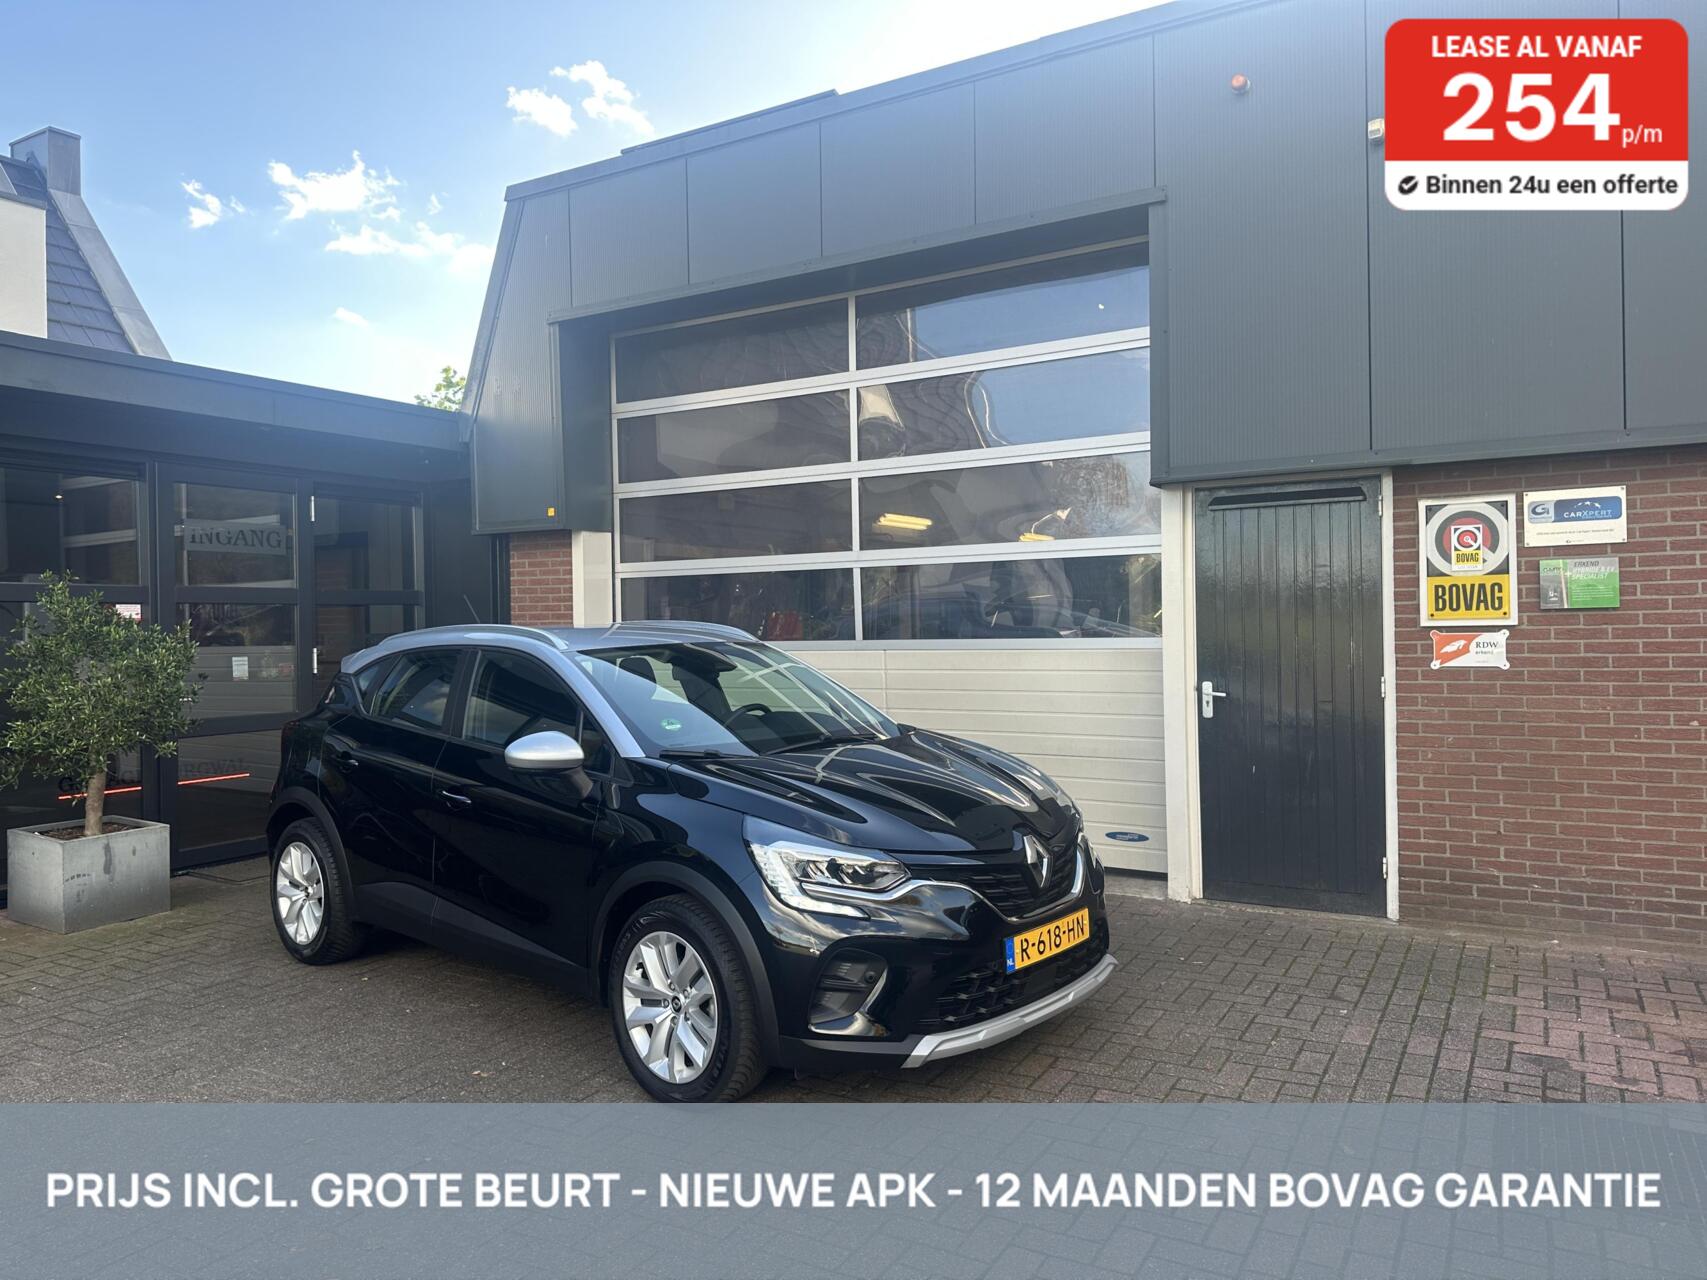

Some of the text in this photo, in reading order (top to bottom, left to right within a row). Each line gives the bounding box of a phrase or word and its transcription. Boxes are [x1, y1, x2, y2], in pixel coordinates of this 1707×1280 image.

[1563, 509, 1613, 519] CARXPERT
[189, 528, 282, 549] INGANG
[1456, 552, 1480, 564] BOVAG
[1433, 582, 1504, 612] BOVAG
[1475, 641, 1499, 649] RDW
[1020, 914, 1085, 963] R-618-HN
